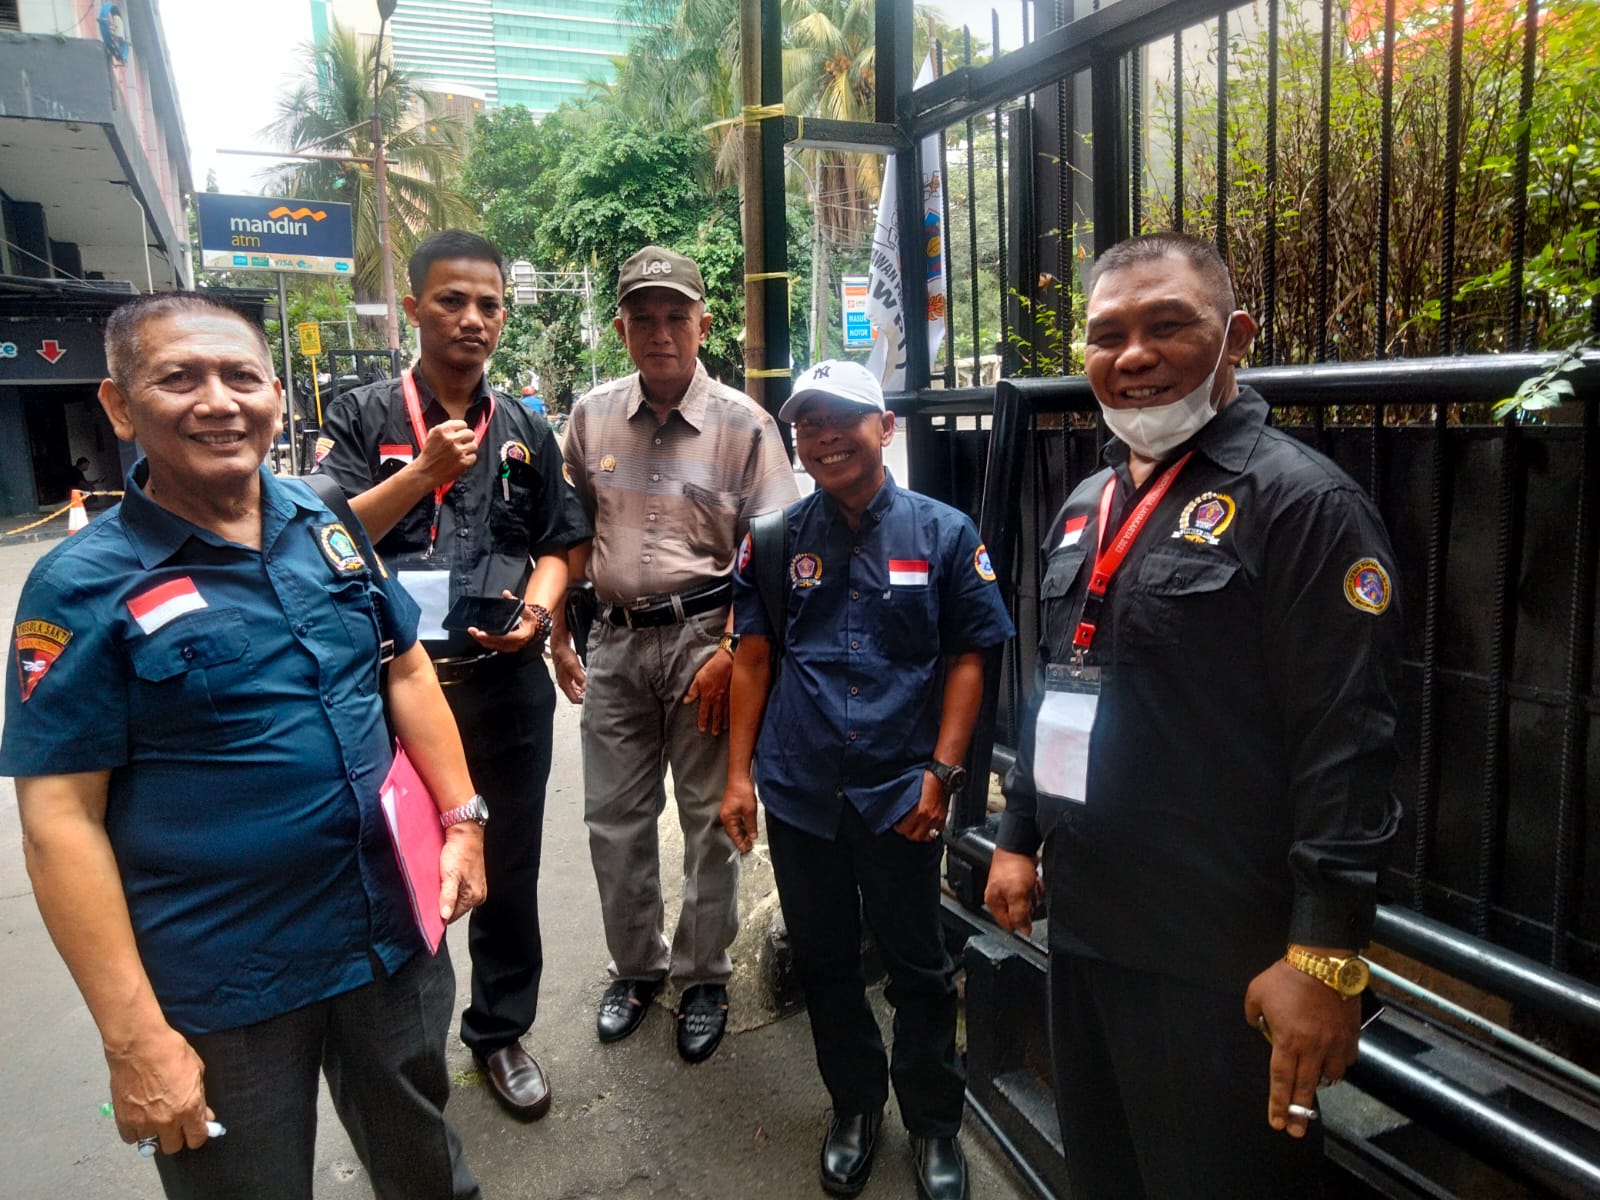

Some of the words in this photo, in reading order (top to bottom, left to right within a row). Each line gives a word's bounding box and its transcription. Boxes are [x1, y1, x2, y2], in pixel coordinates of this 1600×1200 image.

[230, 217, 308, 236] mandiri
[231, 233, 261, 248] atm
[642, 261, 672, 275] Lee
[849, 328, 868, 337] MOTOR
[813, 365, 831, 380] NY
